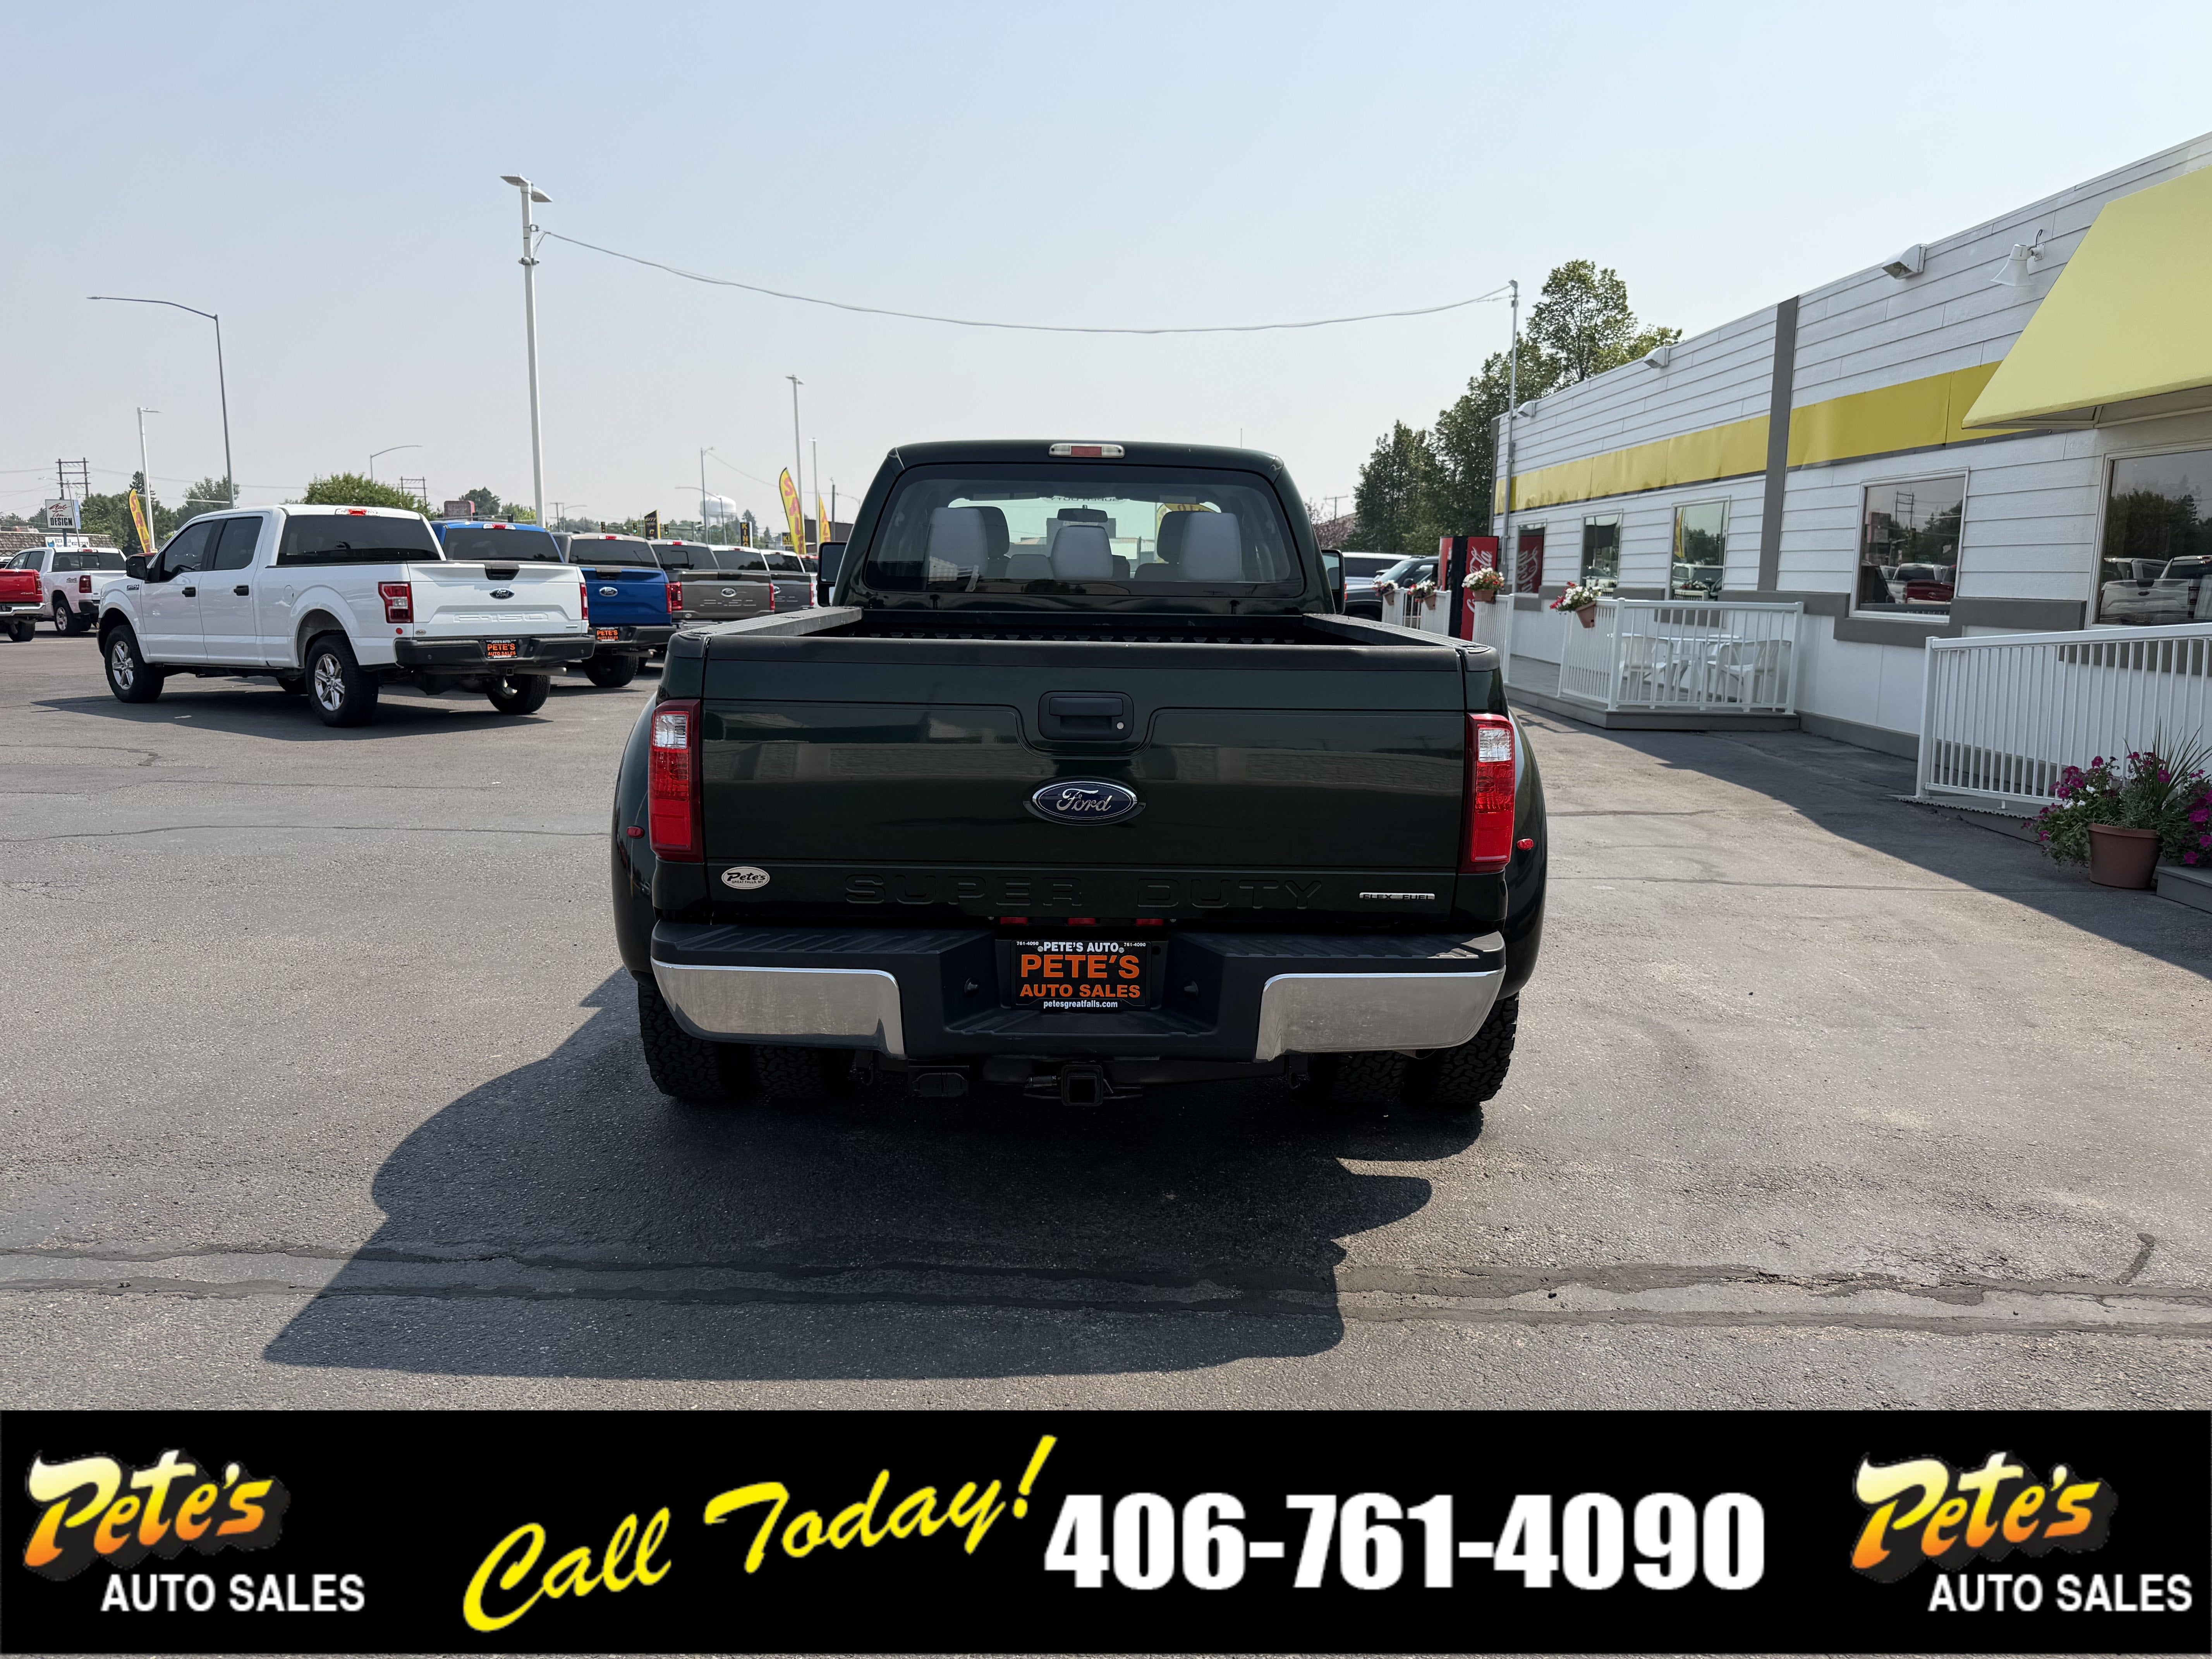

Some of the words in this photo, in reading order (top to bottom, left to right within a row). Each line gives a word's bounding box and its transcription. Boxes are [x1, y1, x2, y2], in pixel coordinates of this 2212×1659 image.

[50, 518, 72, 526] DESIGN
[1056, 788, 1113, 811] Ford
[727, 872, 766, 881] Pete's
[845, 874, 1083, 906] SUPER
[1137, 878, 1322, 909] DUTY
[1044, 942, 1084, 952] PETE'S
[1087, 942, 1119, 952] AUTO
[1021, 954, 1139, 979] PETE'S
[1020, 984, 1073, 997] AUTO
[1079, 984, 1140, 998] SALES
[1043, 998, 1118, 1009] petesgreatfalls.com
